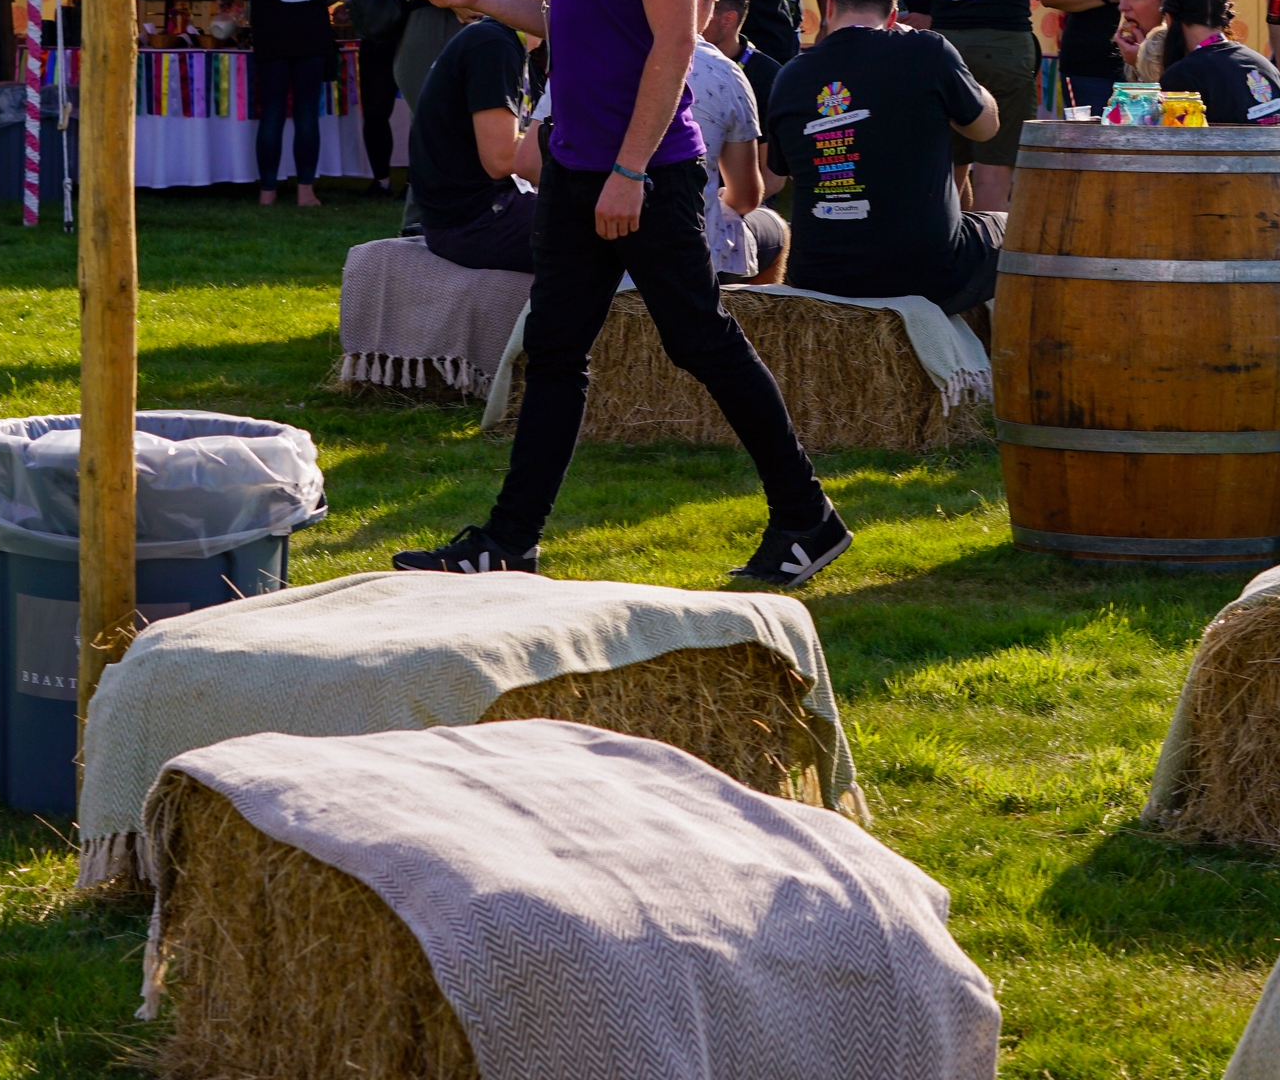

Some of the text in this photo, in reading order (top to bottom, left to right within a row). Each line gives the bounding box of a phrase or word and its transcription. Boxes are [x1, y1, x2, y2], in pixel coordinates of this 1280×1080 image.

[845, 129, 855, 137] IT
[816, 137, 854, 149] MAKE IT
[823, 146, 847, 156] DO IT
[813, 153, 860, 165] MAKES US
[818, 162, 855, 172] HARDER
[22, 670, 78, 689] BRAXT
